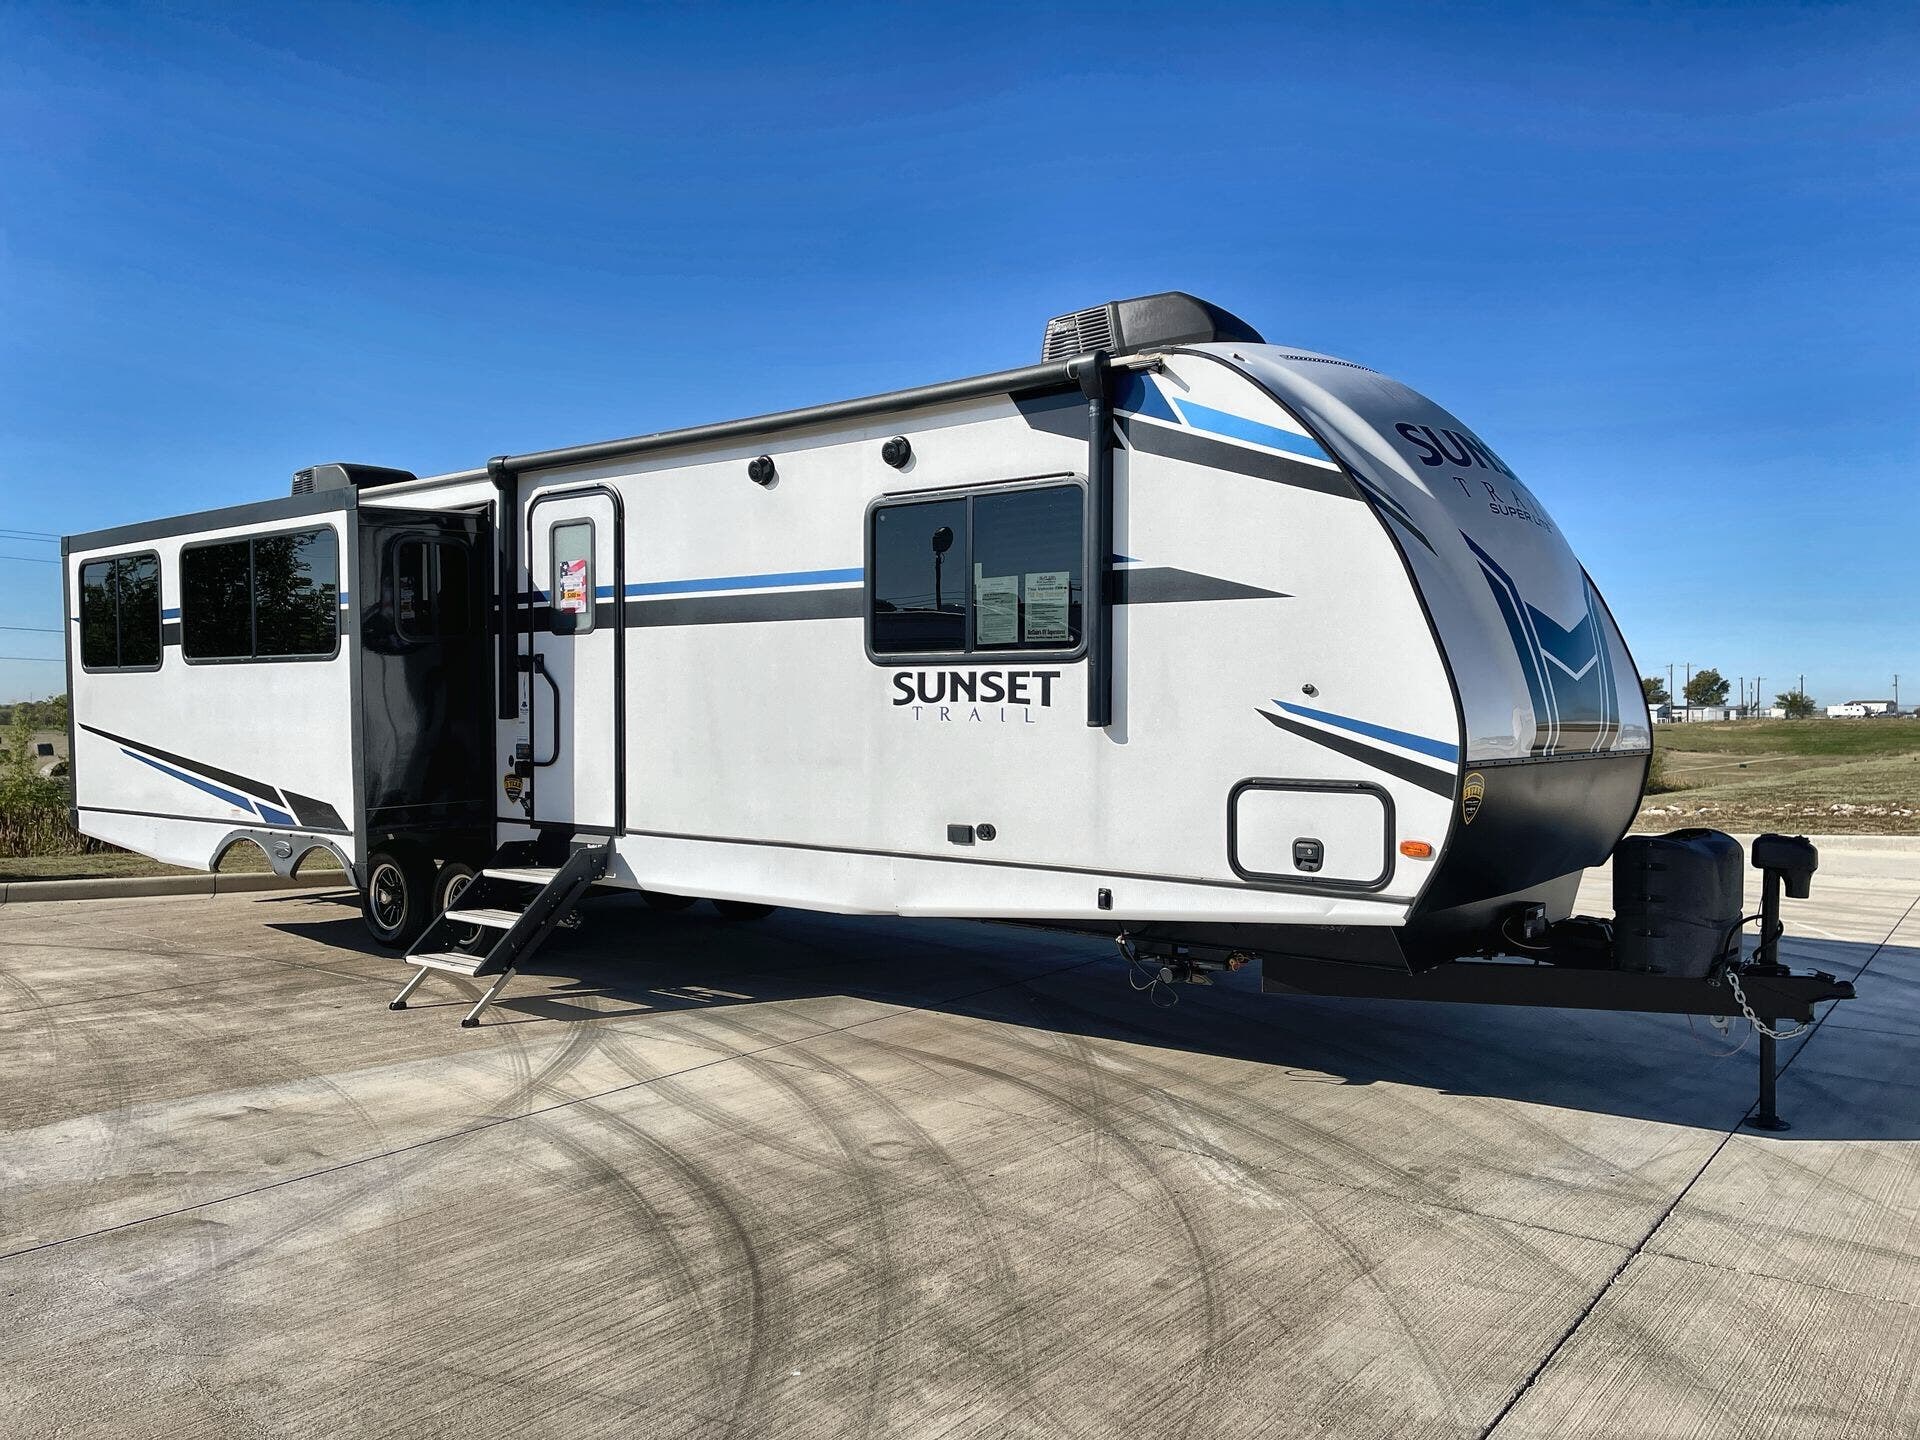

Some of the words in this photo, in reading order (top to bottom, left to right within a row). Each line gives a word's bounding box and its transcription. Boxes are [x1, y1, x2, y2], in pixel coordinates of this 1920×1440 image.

[1489, 502, 1533, 524] SUPER
[892, 671, 1061, 707] SUNSET
[912, 706, 1035, 723] TRAIL
